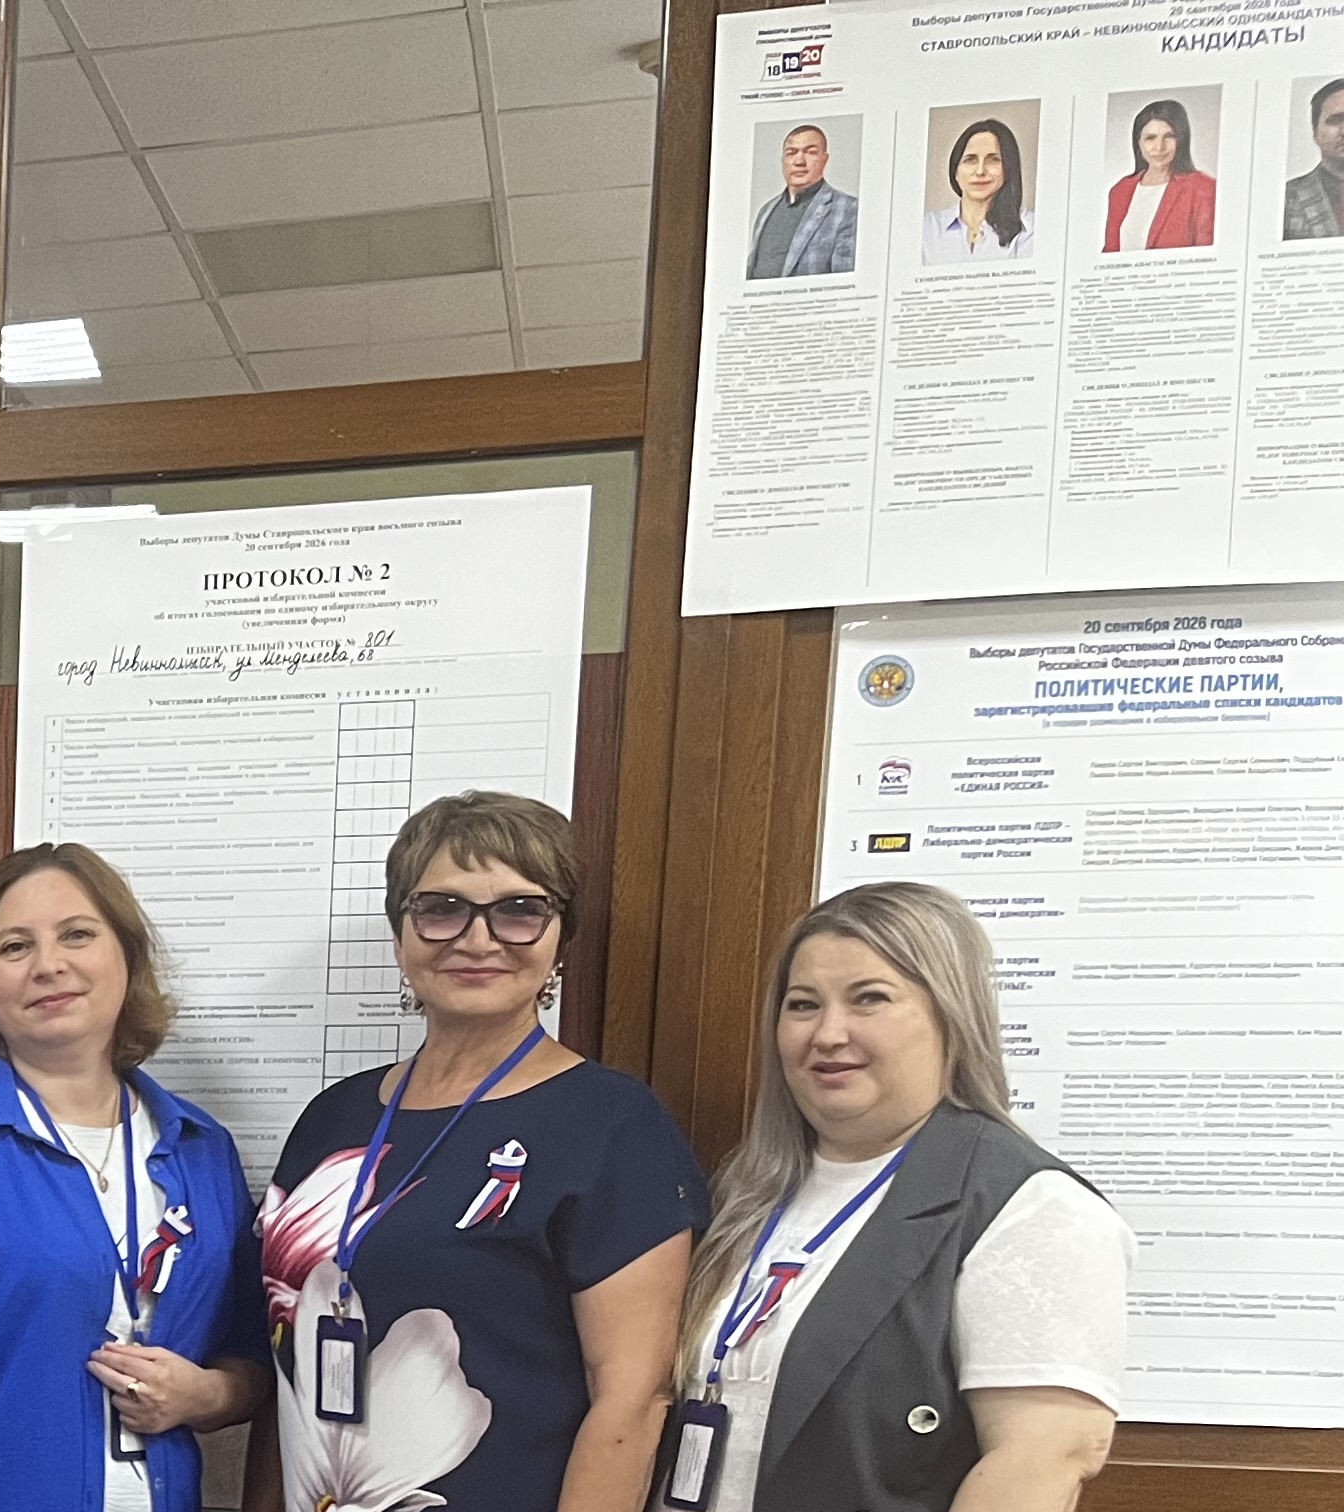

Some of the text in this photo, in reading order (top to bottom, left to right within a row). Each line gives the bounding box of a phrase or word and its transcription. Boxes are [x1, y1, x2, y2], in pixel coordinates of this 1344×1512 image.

[912, 15, 961, 26] Выборы
[963, 10, 1023, 23] депутатов
[1170, 7, 1182, 16] 20
[921, 31, 1042, 52] СТАВРОПОЛЬСКИЙ
[1046, 26, 1080, 40] КРАЙ
[1093, 14, 1224, 36] НЕВИННОМЫССКИЙ
[1162, 25, 1305, 53] КАНДИДАТЫ
[768, 65, 780, 76] 18
[784, 56, 799, 69] 19
[802, 49, 819, 62] 20
[140, 537, 179, 547] Выборы
[232, 532, 260, 541] Думы
[245, 543, 255, 551] 20
[258, 541, 302, 551] сентября
[305, 539, 326, 548] 2026
[204, 563, 391, 591] ПРОТОКОЛ № 2
[1083, 616, 1242, 634] 20 сентября 2026 года
[364, 630, 395, 648] 801
[970, 646, 1016, 659] Выборы
[1079, 639, 1175, 655] Государственной
[1178, 639, 1211, 652] Думы
[1214, 637, 1298, 650] Федерального
[57, 659, 97, 686] город
[357, 649, 375, 662] 68
[1038, 654, 1283, 671] Российской Федерации девятого созыва
[1034, 673, 1284, 699] ПОЛИТИЧЕСКИЕ ПАРТИИ,
[1117, 698, 1210, 714] федеральные
[1265, 695, 1343, 707] кандидатов
